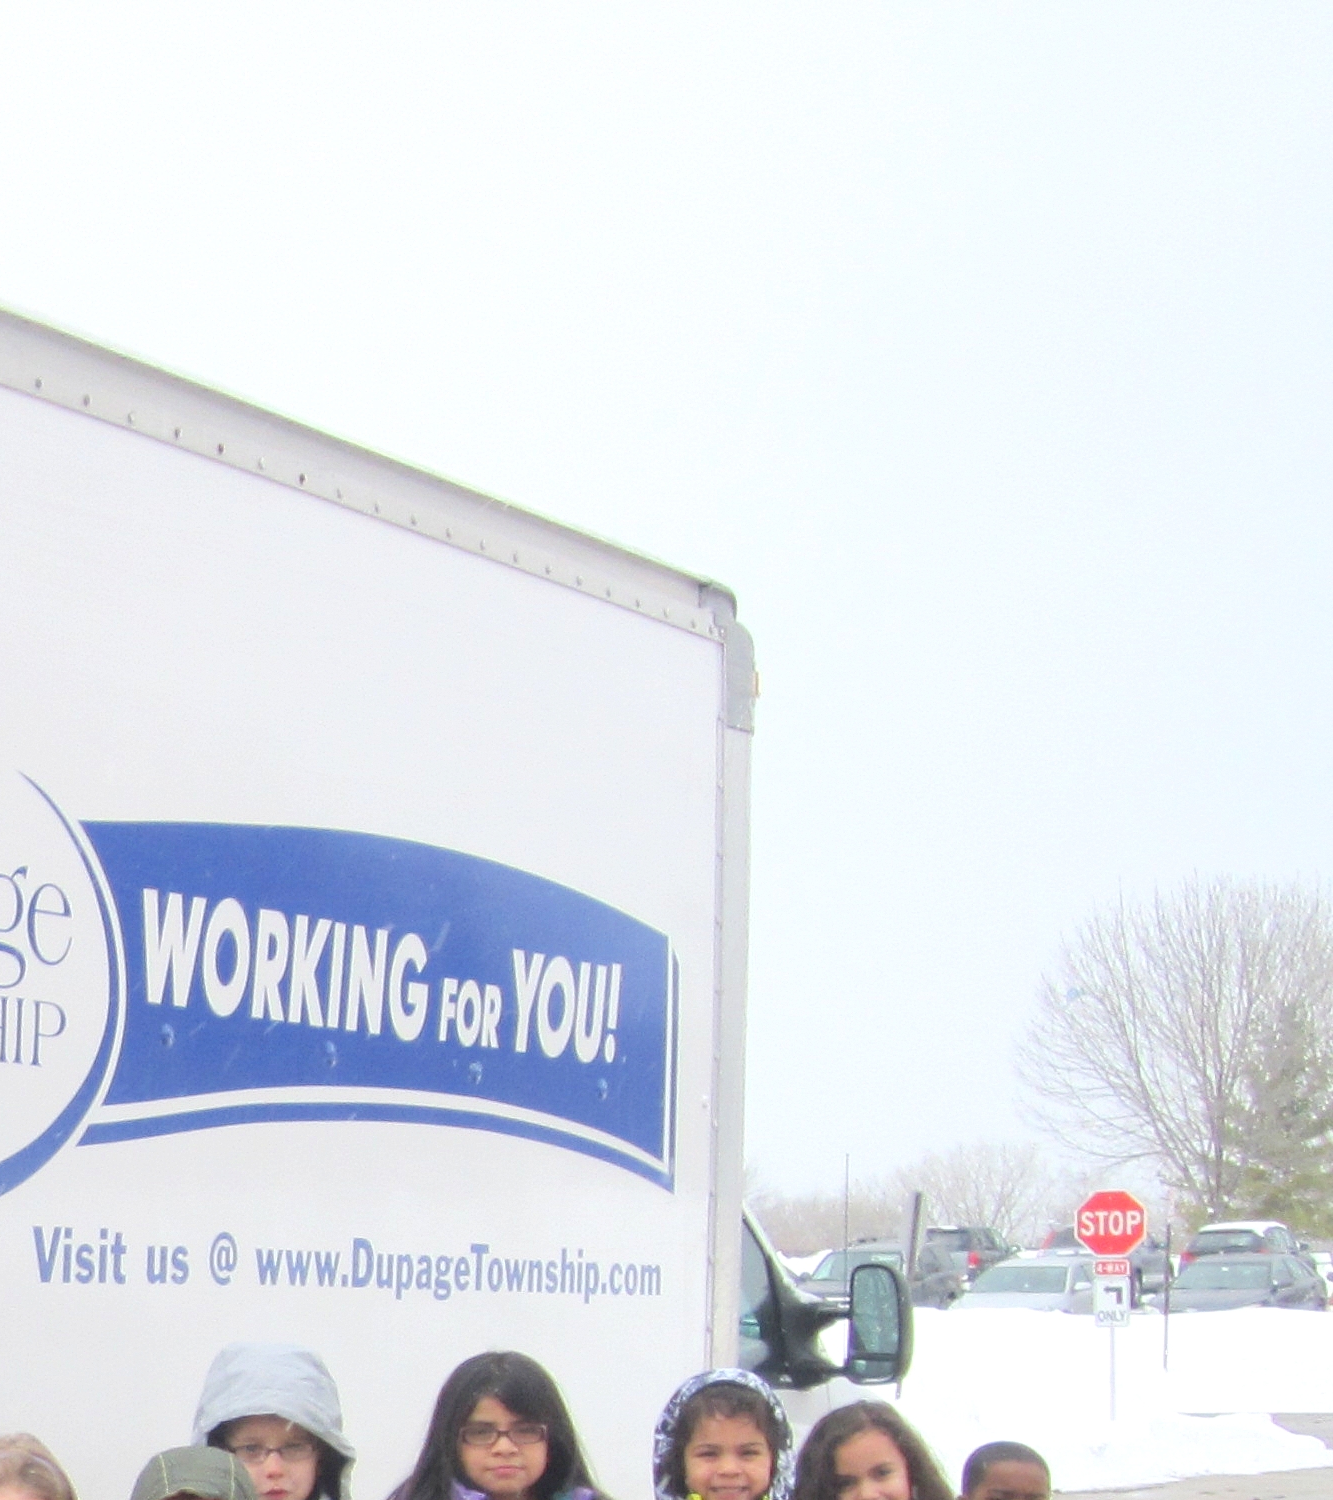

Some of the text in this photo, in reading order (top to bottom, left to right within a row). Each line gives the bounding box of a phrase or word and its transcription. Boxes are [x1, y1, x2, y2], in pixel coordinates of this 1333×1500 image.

[141, 887, 624, 1065] WORKING FOR YOU!
[1080, 1209, 1141, 1237] STOP
[32, 1224, 663, 1305] Visit us @ www.DupageTownship.com
[1096, 1262, 1127, 1274] 4-WAY
[1097, 1310, 1126, 1322] ONLY
